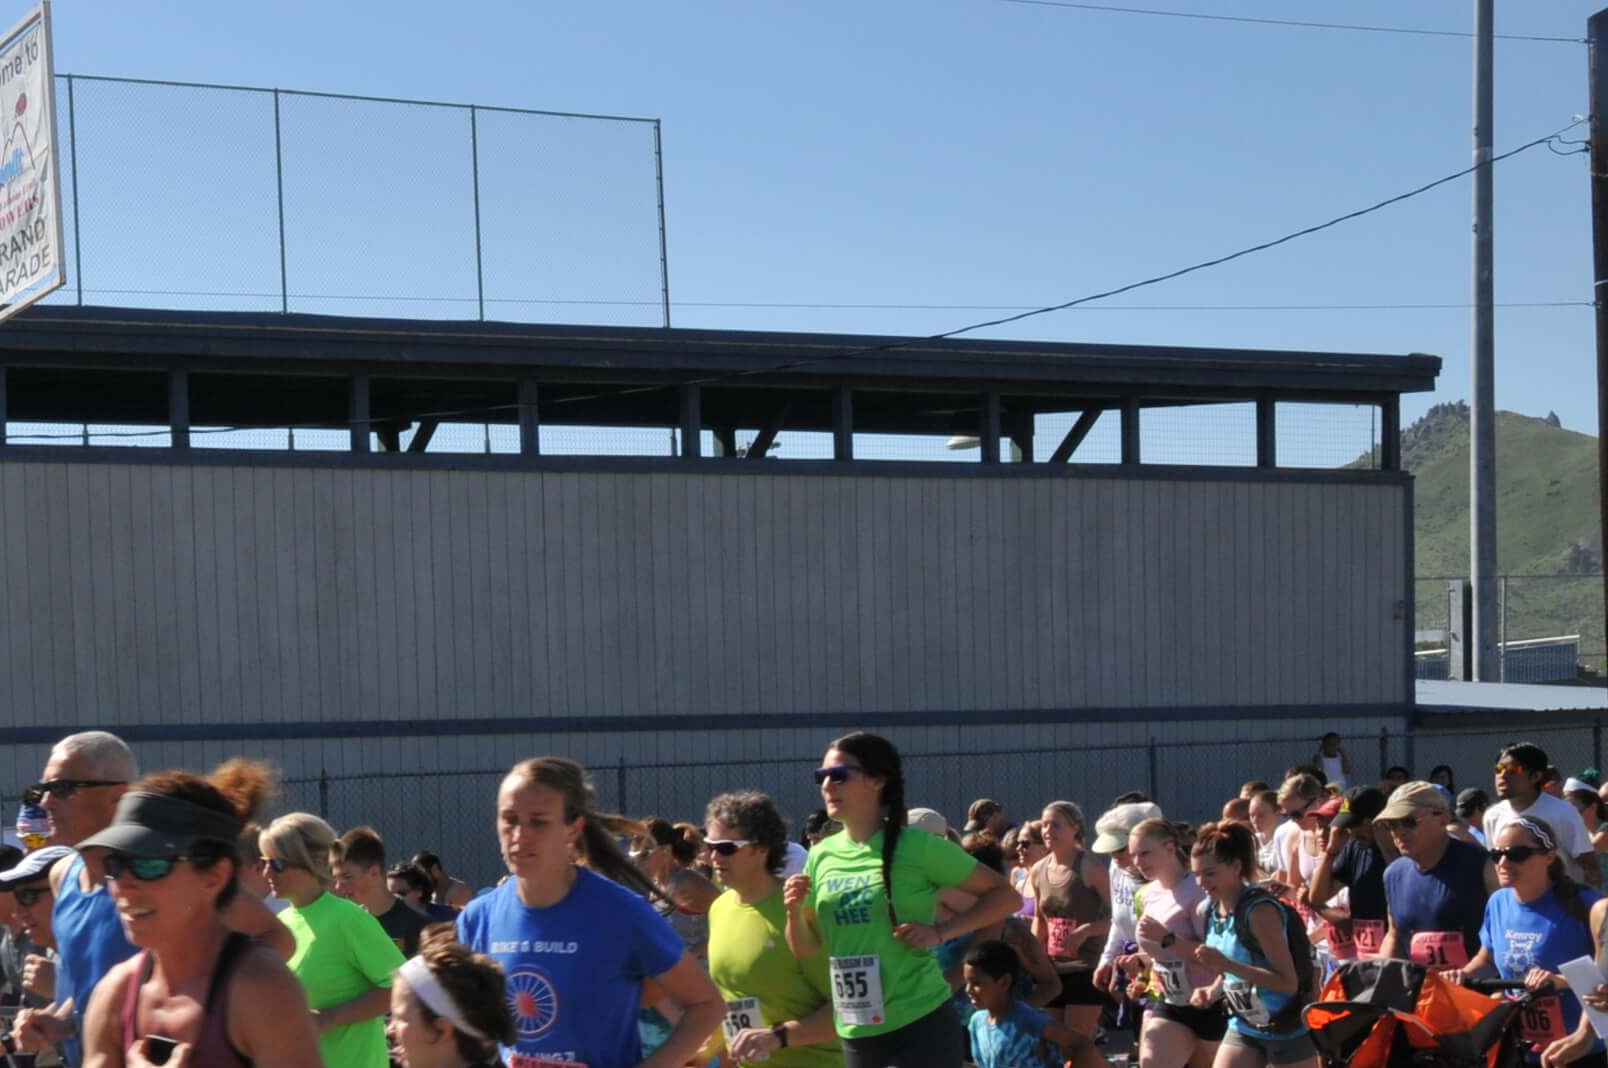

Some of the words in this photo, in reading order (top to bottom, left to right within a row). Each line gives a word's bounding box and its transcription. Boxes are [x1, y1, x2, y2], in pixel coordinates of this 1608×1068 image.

[25, 41, 39, 66] to
[827, 875, 871, 894] WEN
[834, 907, 872, 926] HEE
[491, 941, 520, 954] BIKE
[533, 941, 579, 954] BUILD
